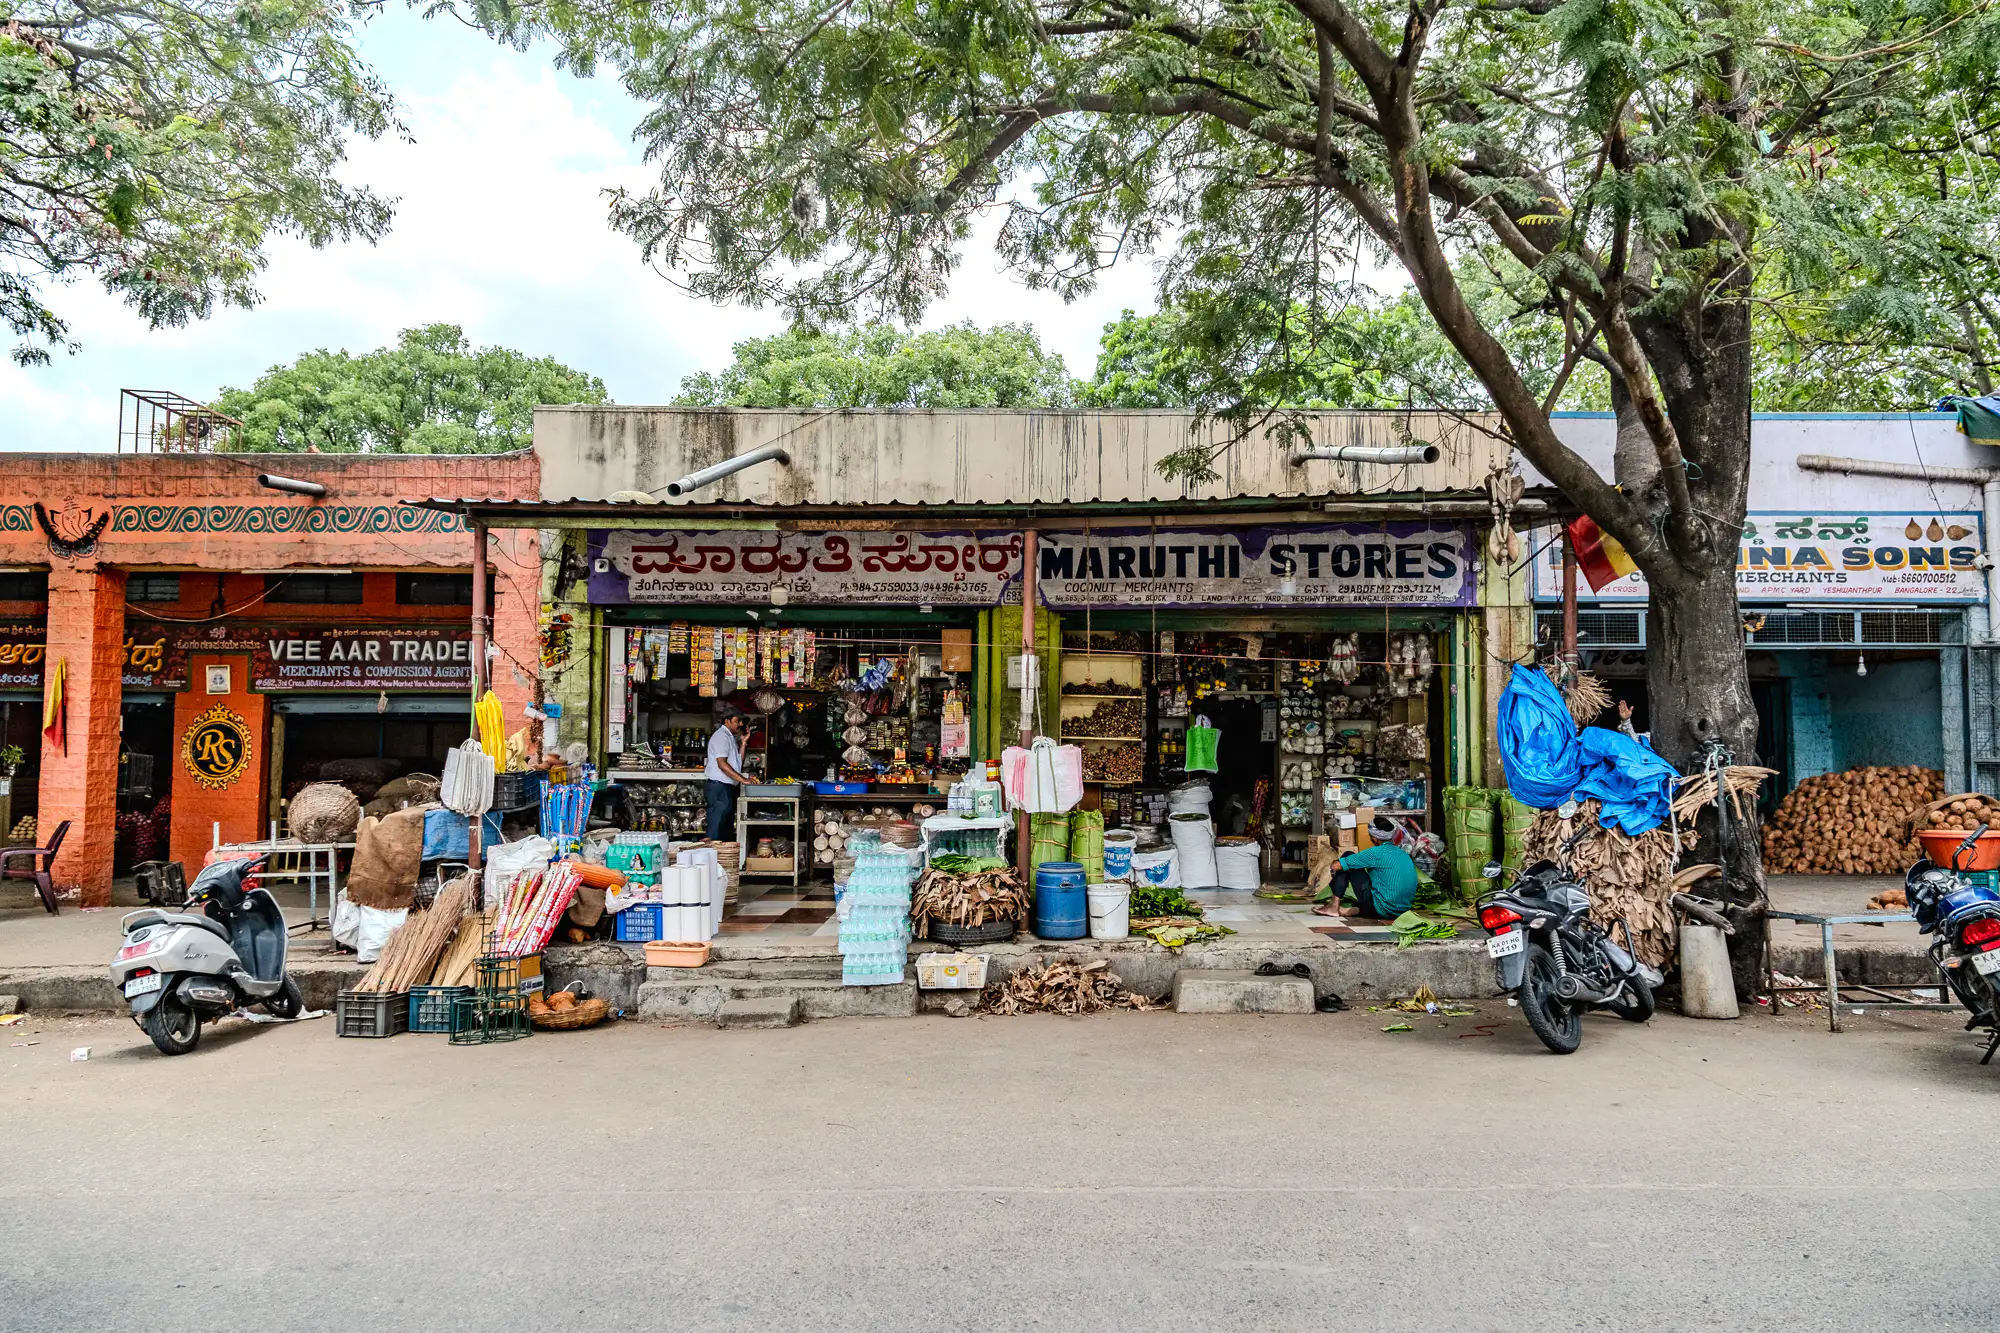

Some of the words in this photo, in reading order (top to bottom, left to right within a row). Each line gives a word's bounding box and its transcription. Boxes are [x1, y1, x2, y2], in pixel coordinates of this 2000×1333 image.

[631, 534, 853, 575] ಮಾರುತಿ
[1041, 545, 1240, 579] MARUTHI
[1269, 543, 1458, 579] STORES
[1842, 546, 1979, 572] SONS
[1064, 582, 1116, 593] COCONUT
[1124, 582, 1194, 593] MERCHANTS
[1823, 586, 1882, 594] YESHWANTHPUR
[1894, 586, 1939, 594] BANGALORE
[1097, 594, 1117, 602] CROSS
[1145, 594, 1167, 602] BLOCK
[268, 639, 322, 661] VEE
[329, 639, 381, 661] AAR
[389, 639, 473, 661] TRADE
[278, 665, 350, 677] MERCHANTS
[352, 666, 361, 677] &
[365, 665, 433, 677] COMMISSION
[434, 665, 472, 678] AGENT
[1981, 952, 1996, 963] KA
